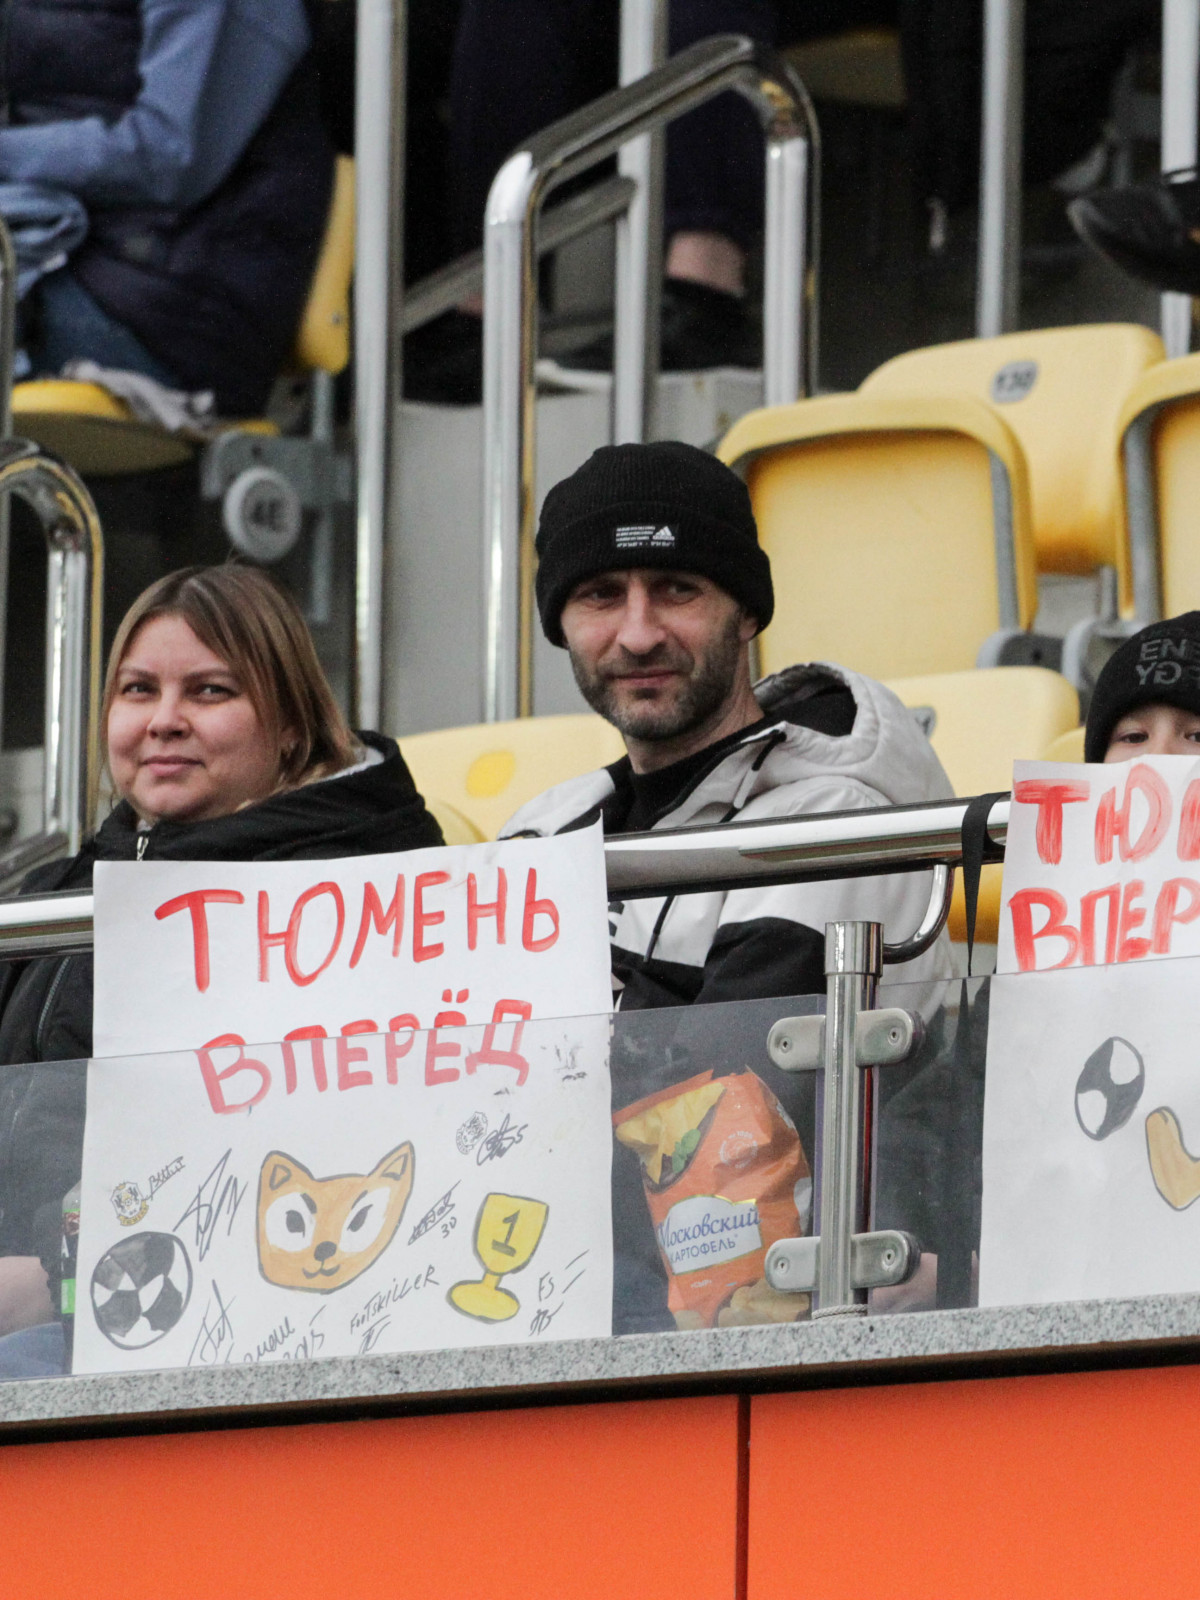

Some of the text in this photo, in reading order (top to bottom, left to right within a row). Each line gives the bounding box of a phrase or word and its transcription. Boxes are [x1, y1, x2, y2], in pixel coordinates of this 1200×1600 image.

[154, 866, 560, 993] ТЮМЕНЬ
[193, 988, 533, 1114] ВПЕРЁД
[491, 1209, 521, 1257] 1
[657, 1206, 762, 1250] Московский
[669, 1238, 737, 1263] КАРТОФЕЛЬ
